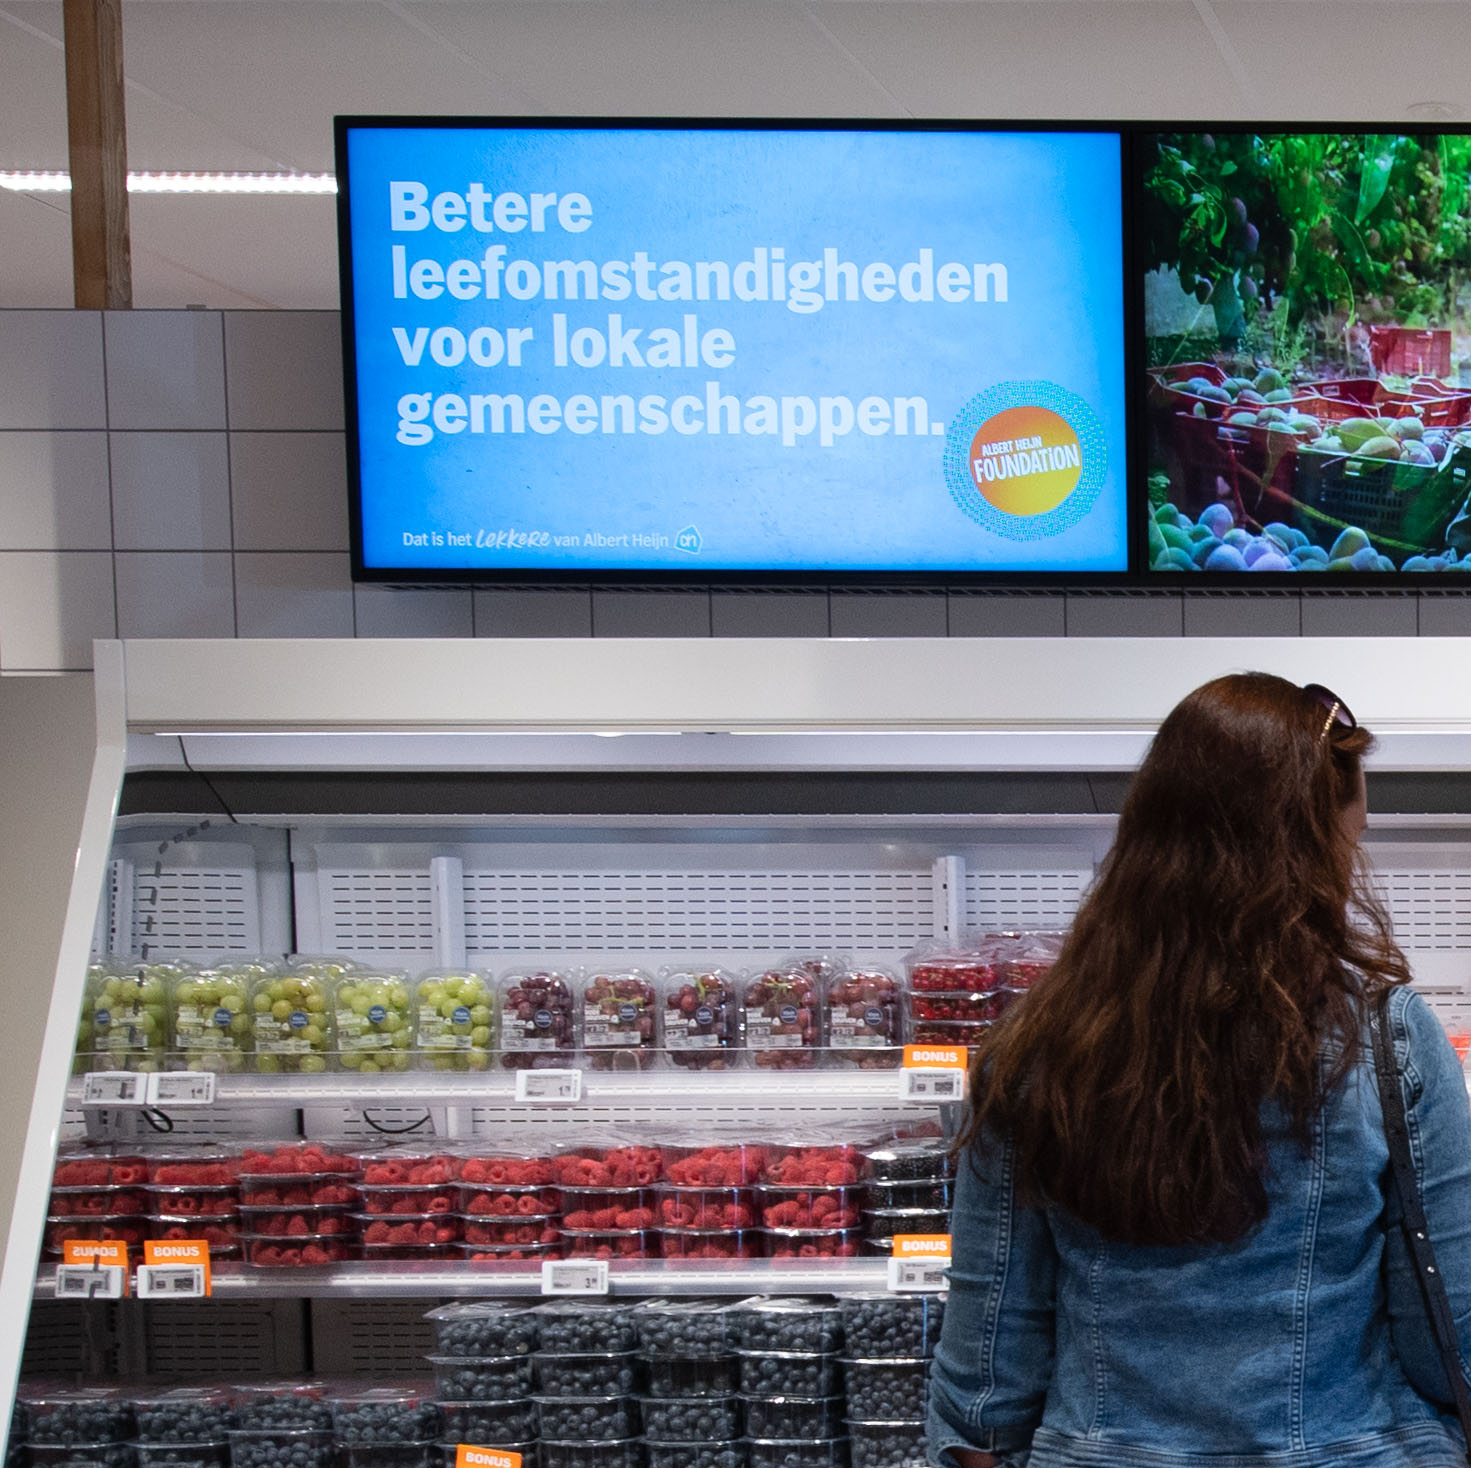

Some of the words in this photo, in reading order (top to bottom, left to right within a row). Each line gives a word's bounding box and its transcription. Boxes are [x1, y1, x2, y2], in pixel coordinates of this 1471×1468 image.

[390, 181, 593, 233] Betere
[392, 245, 1009, 315] leefomstandigheden
[393, 323, 533, 368] voor
[553, 314, 736, 369] lokale
[397, 381, 945, 447] gemeenschappen.
[981, 440, 1014, 457] ALBERT
[1014, 435, 1043, 453] HEIJN
[403, 532, 429, 547] Dat
[431, 531, 445, 547] is
[447, 532, 473, 547] het
[553, 535, 580, 547] van
[583, 532, 628, 548] Albert
[632, 532, 669, 550] Heijn
[912, 1051, 958, 1063] BONUS
[154, 1246, 200, 1257] BONUS
[902, 1240, 948, 1252] BONUS
